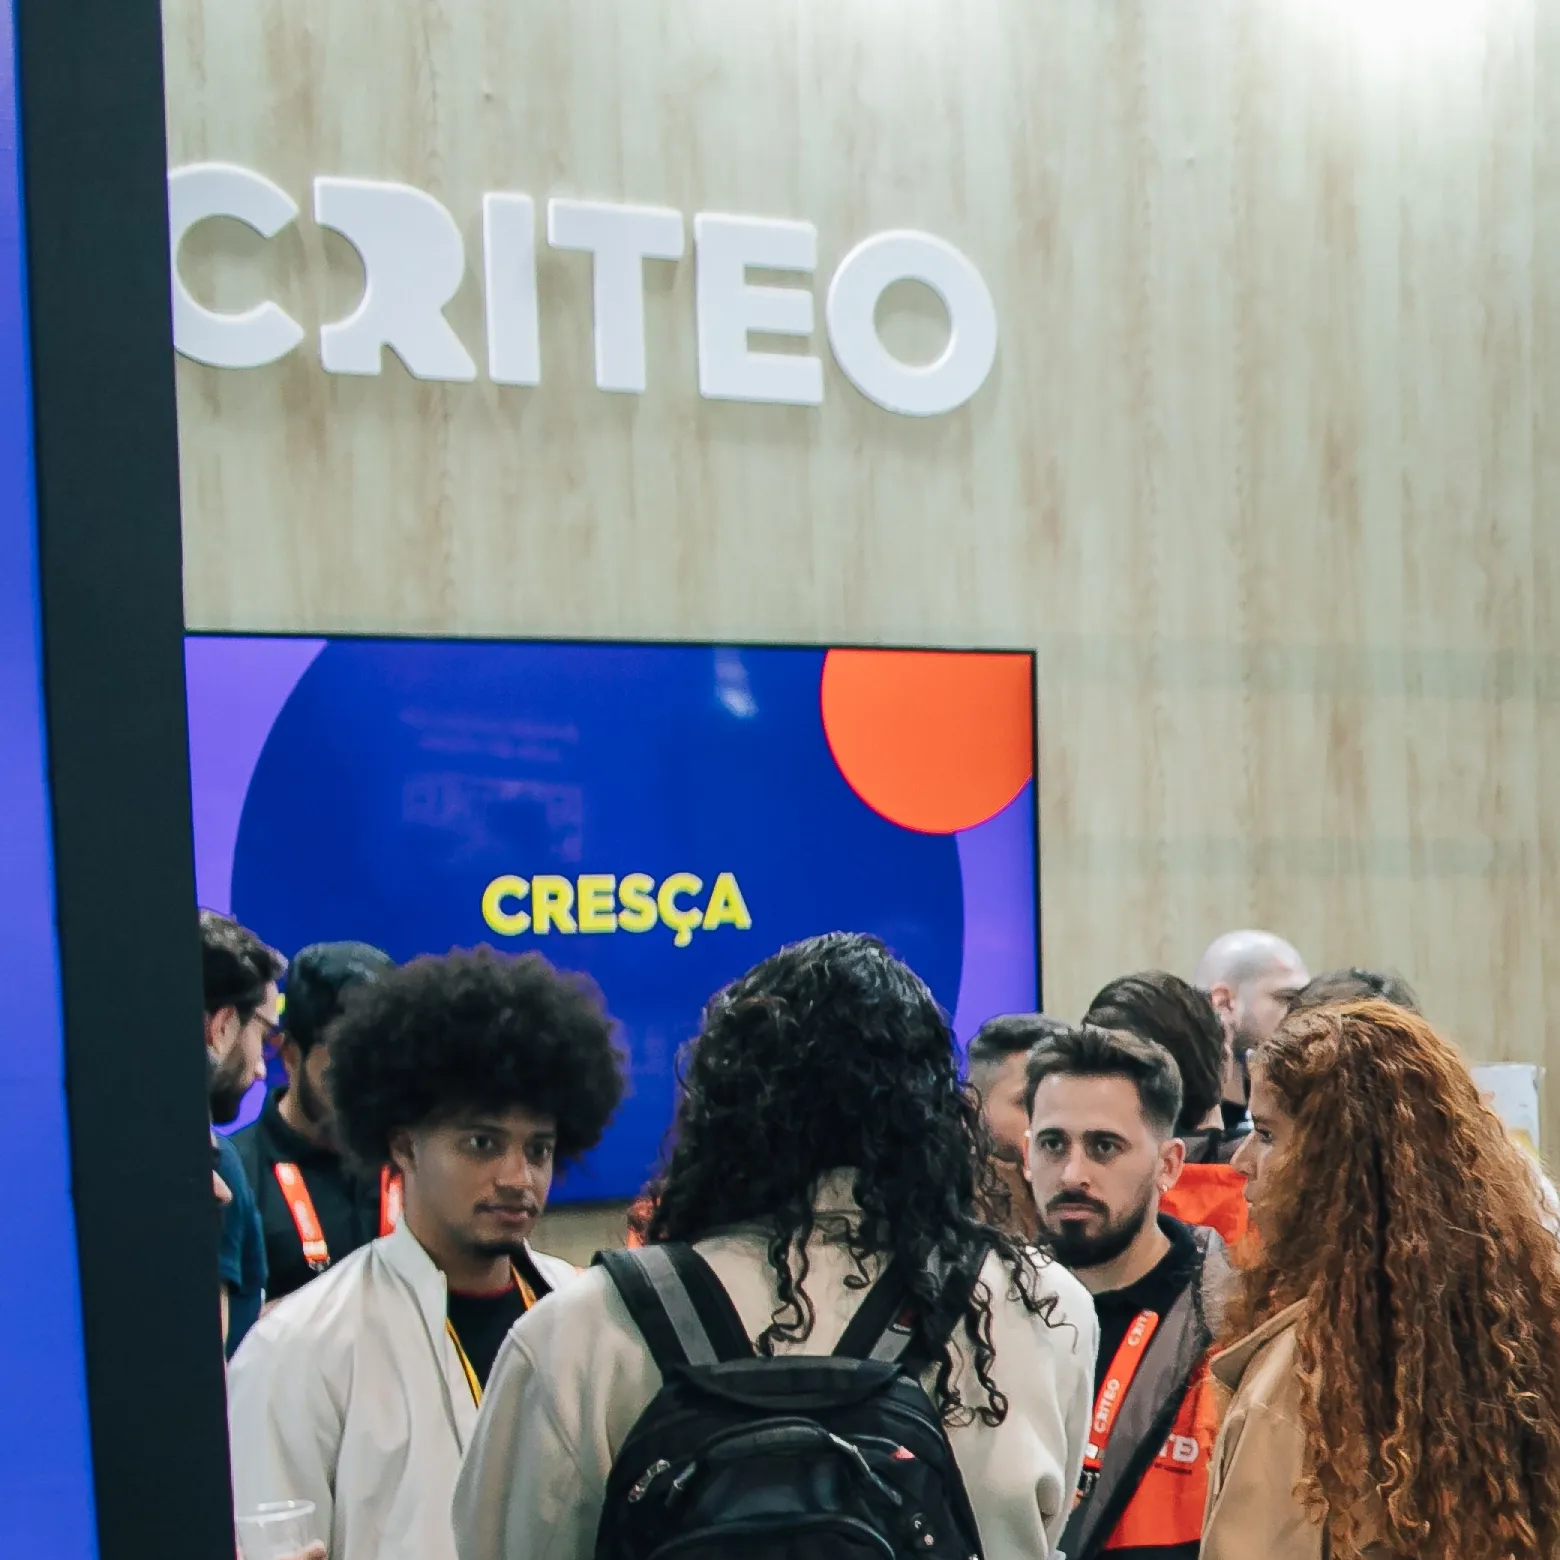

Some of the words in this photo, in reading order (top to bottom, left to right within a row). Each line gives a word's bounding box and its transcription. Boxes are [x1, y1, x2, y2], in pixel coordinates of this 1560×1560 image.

[169, 162, 998, 415] CRITEO
[481, 873, 753, 946] CRESÇA
[1093, 1378, 1121, 1434] CRITEO
